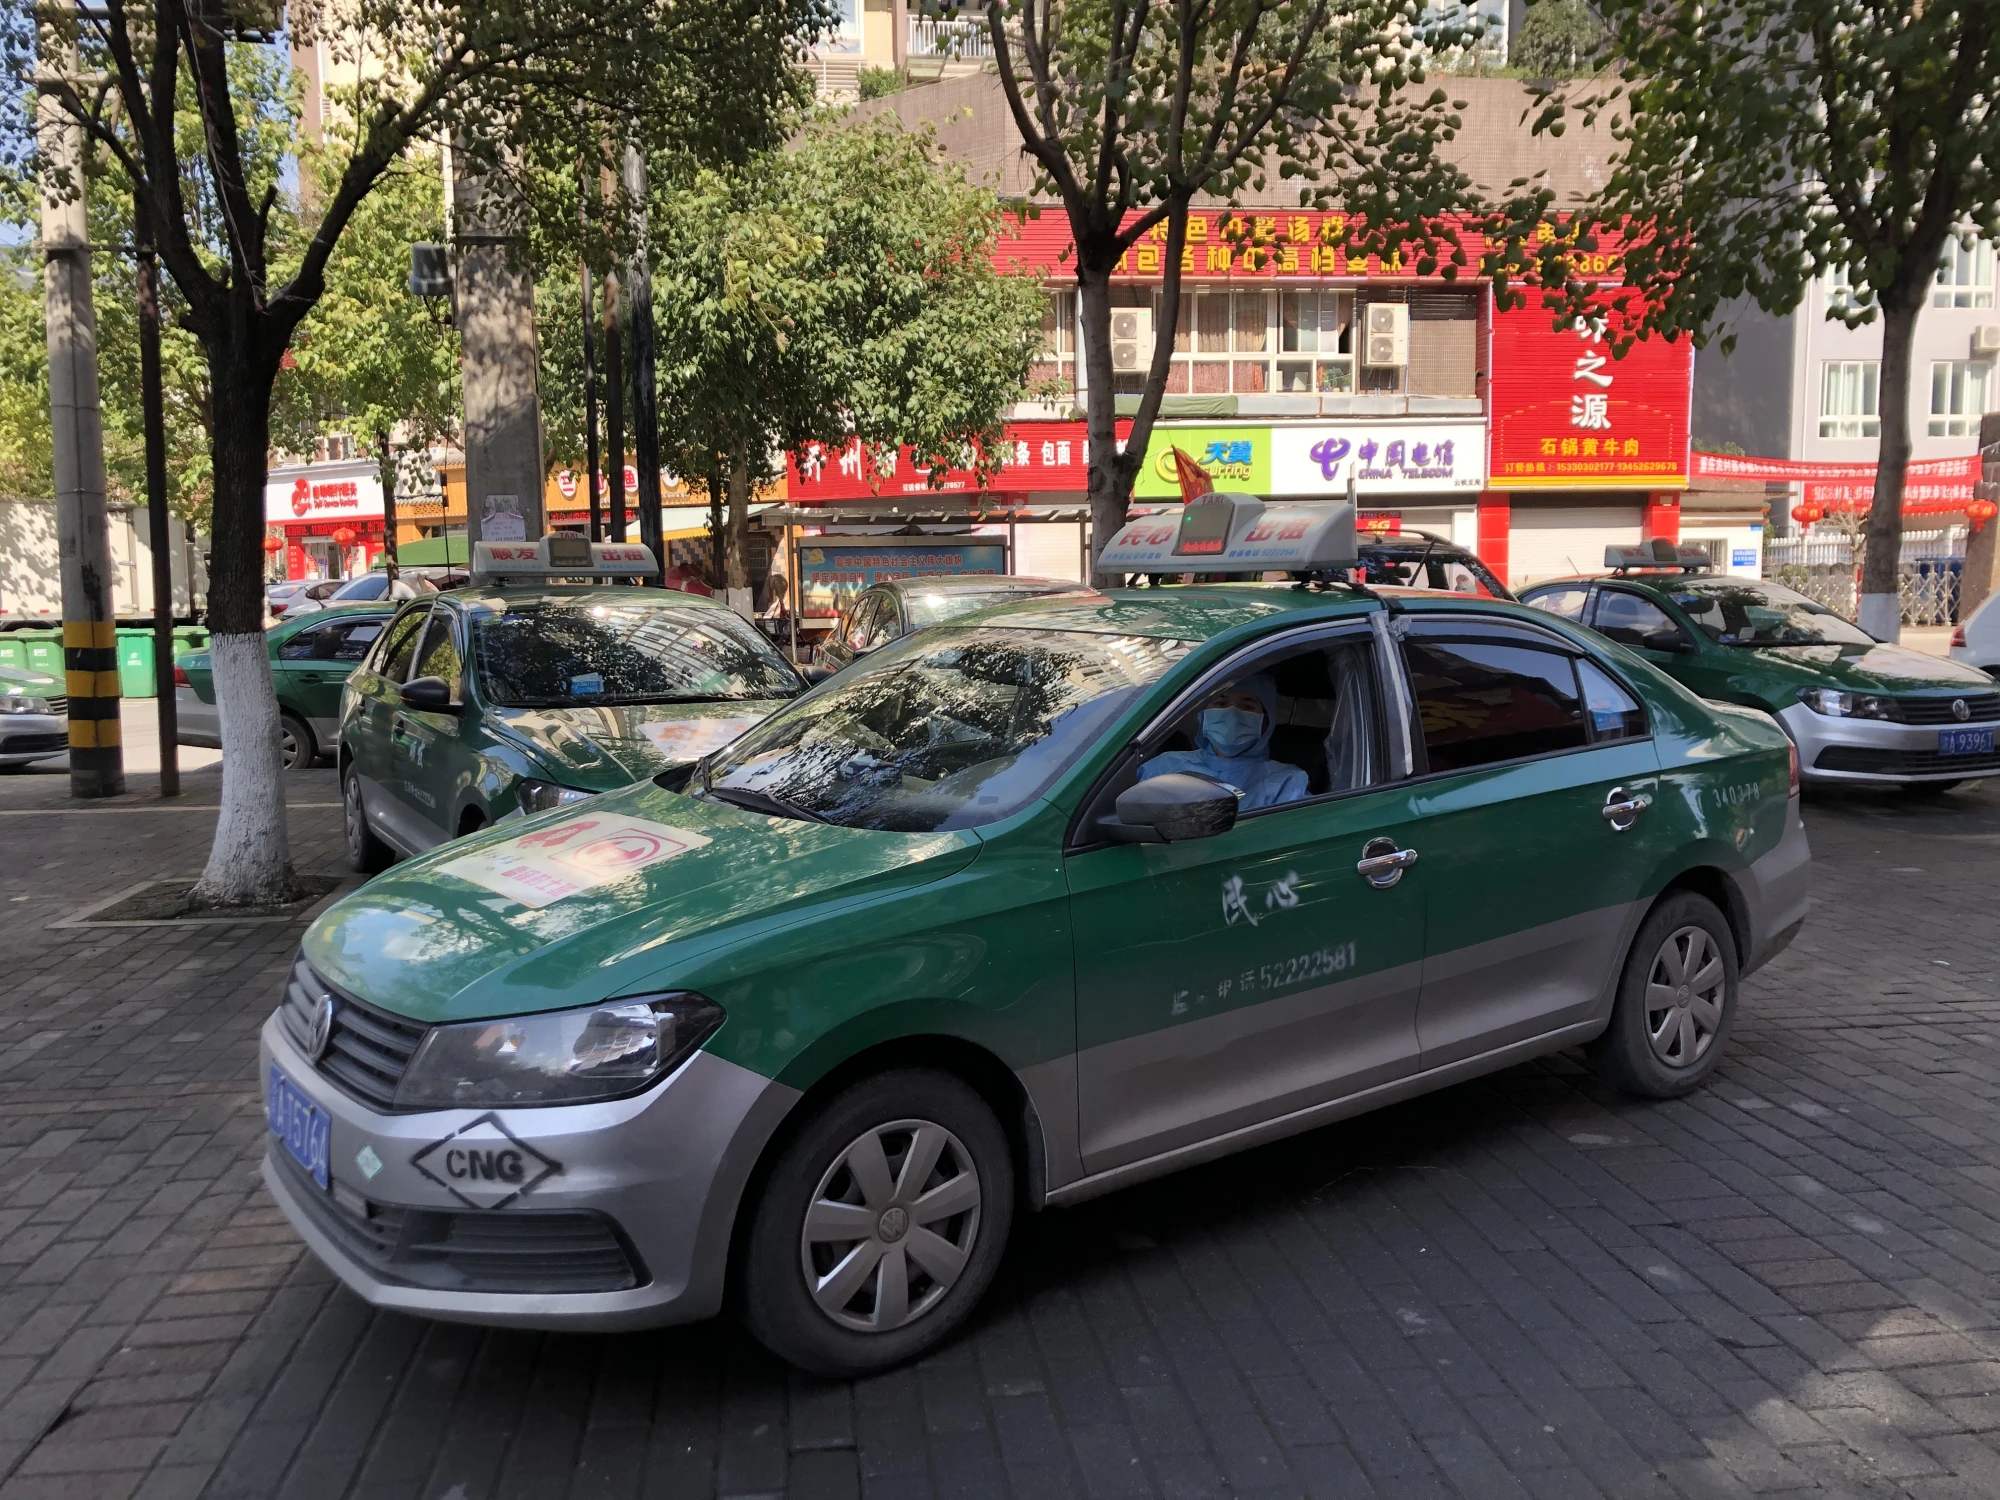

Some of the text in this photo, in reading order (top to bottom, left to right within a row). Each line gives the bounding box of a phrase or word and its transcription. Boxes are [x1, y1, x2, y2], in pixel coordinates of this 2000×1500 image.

[1041, 440, 1071, 466] 包面
[1199, 440, 1252, 465] 天翼
[1358, 438, 1455, 468] 中国电信
[1541, 438, 1640, 457] 石锅黄牛肉
[1358, 465, 1453, 480] CHINA TELECOM
[1119, 524, 1175, 547] 民心
[1244, 519, 1310, 543] 出租
[490, 547, 646, 562] 顺友 出租
[1222, 870, 1300, 927] 民心
[446, 1149, 524, 1183] CNG
